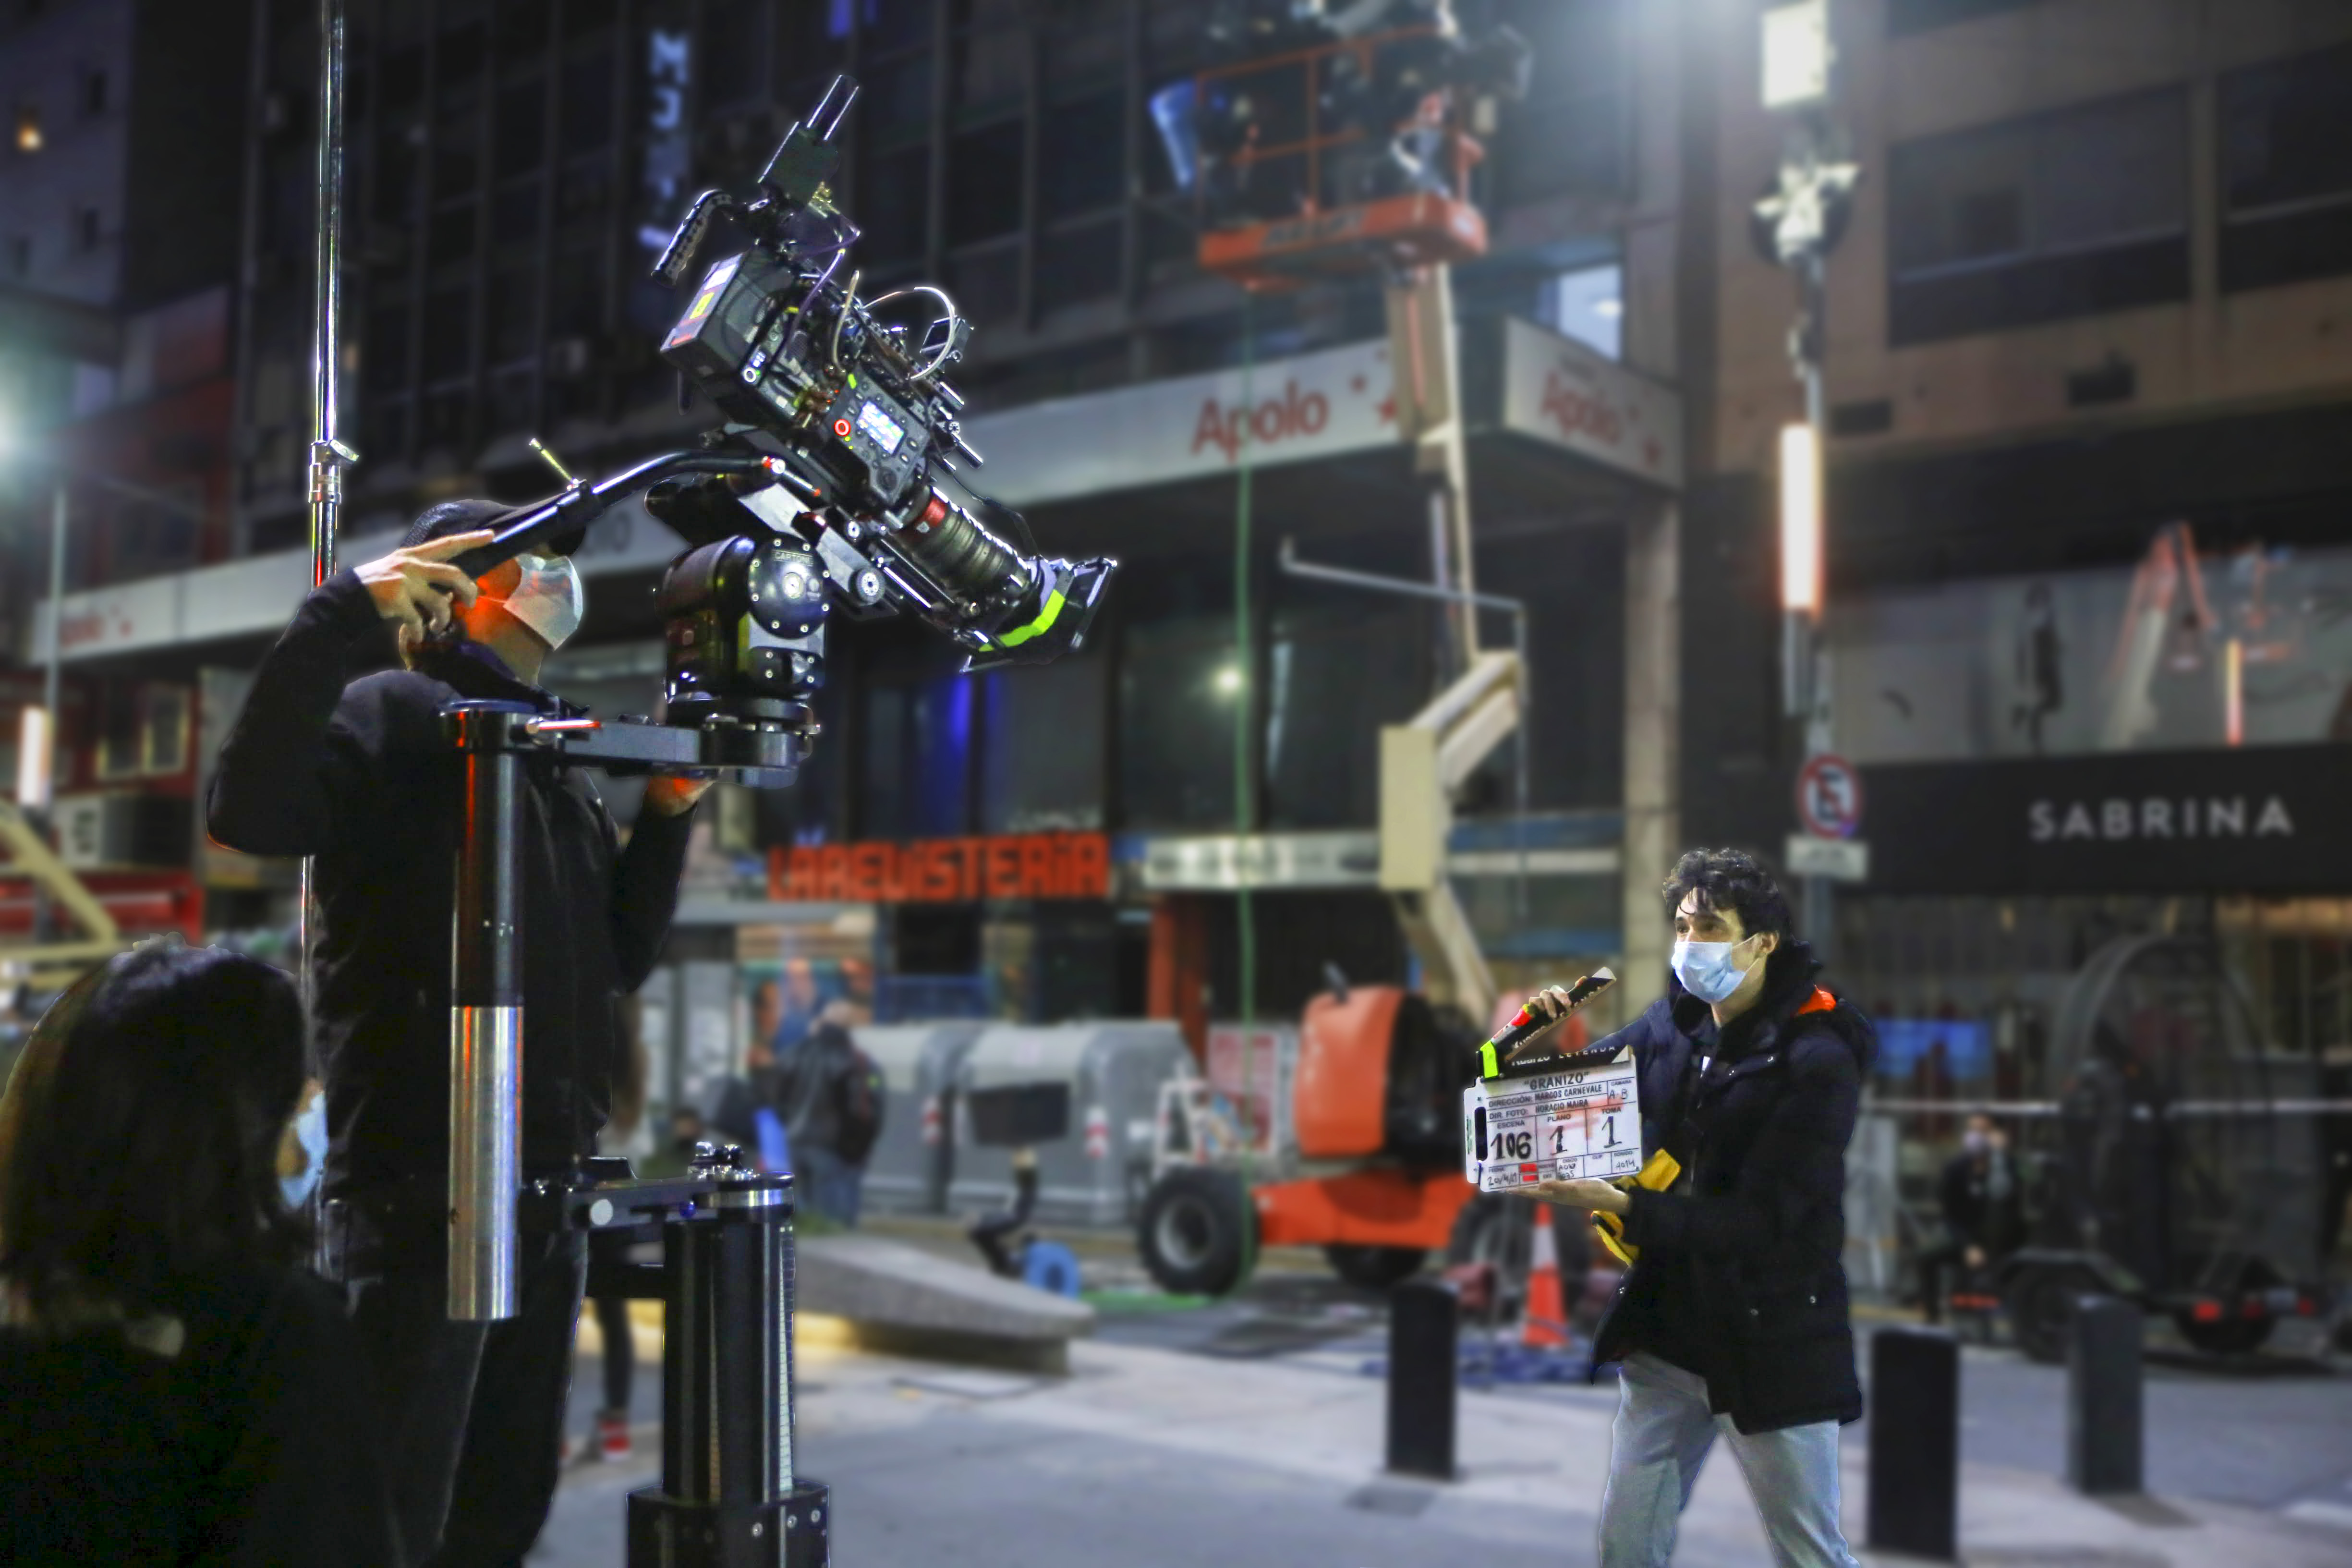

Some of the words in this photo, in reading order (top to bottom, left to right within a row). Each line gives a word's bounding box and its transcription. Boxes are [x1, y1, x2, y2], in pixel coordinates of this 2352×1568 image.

[1191, 377, 1330, 465] Apolo
[2027, 793, 2295, 844] SABRINA
[1535, 1090, 1562, 1102] MARCOS
[1564, 1084, 1602, 1097] CARNEVALE
[1536, 1102, 1564, 1113] HORACIO
[1567, 1099, 1588, 1109] MAIRA
[1497, 1120, 1525, 1129] ESCENA
[1547, 1114, 1571, 1122] PLANO
[1602, 1116, 1622, 1148] 1
[1491, 1132, 1532, 1160] 106
[1549, 1125, 1568, 1155] 1
